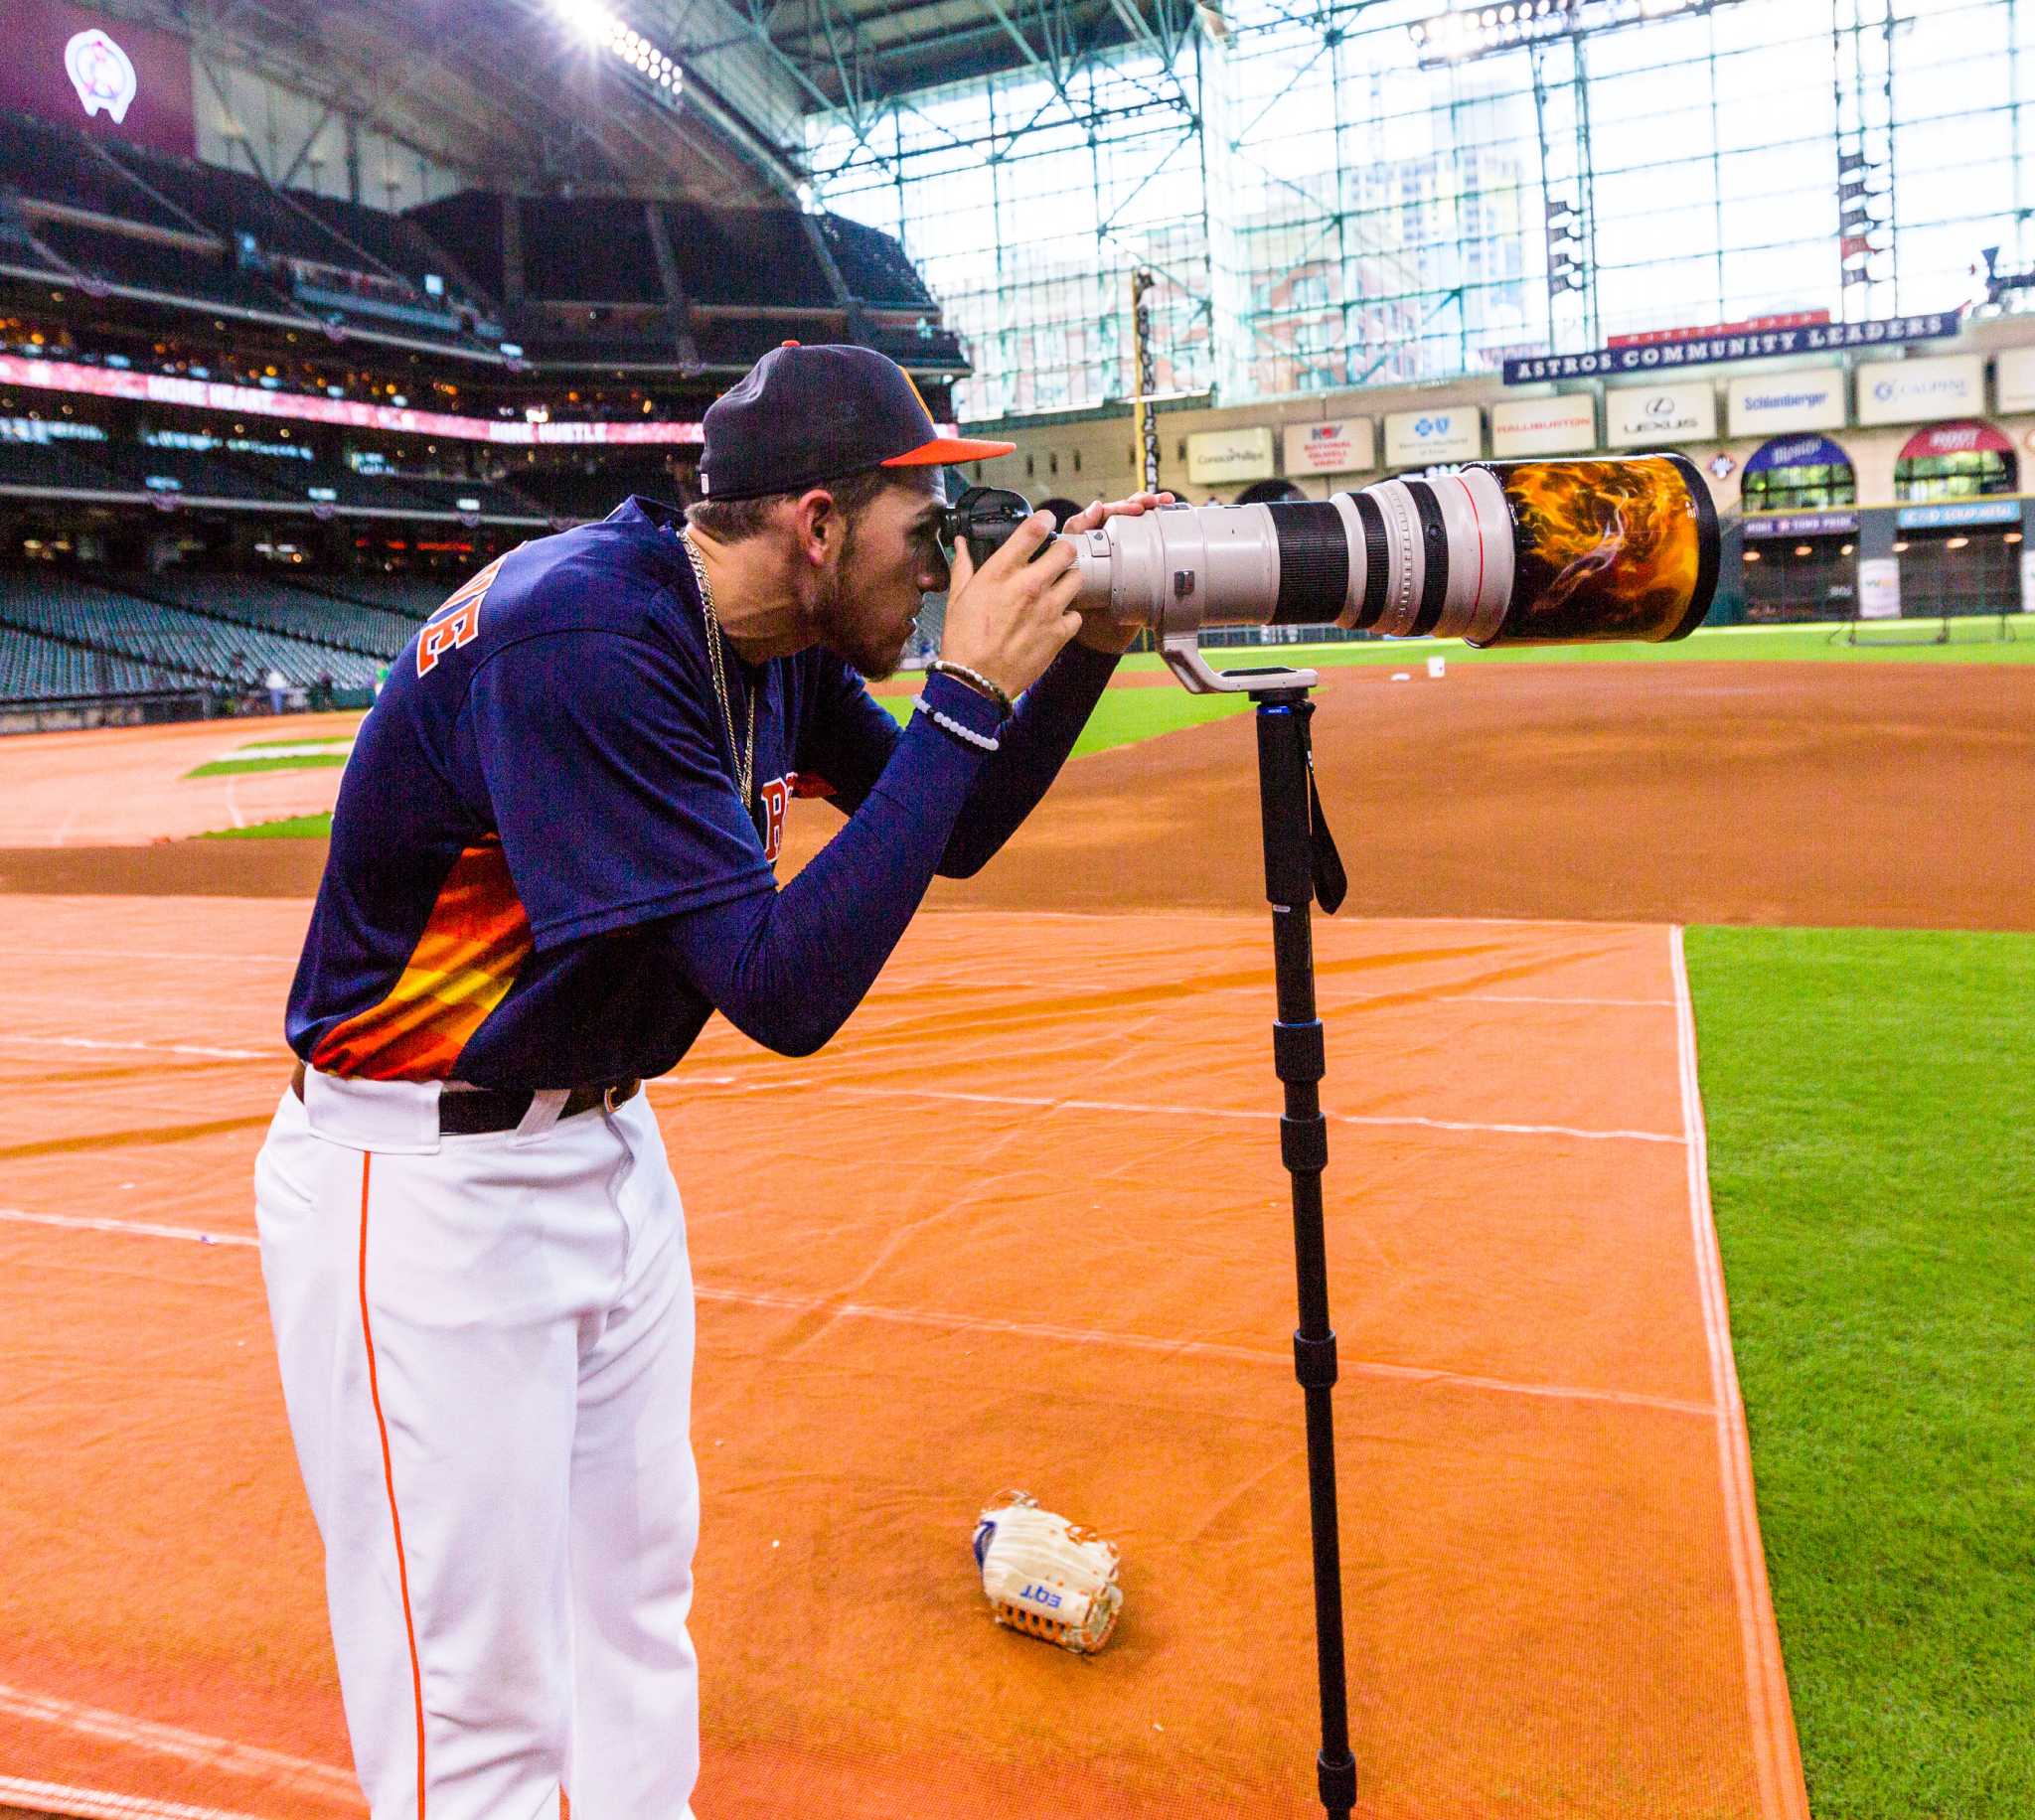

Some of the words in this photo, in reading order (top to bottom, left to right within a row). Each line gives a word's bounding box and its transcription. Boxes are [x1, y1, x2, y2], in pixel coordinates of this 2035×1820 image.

[1517, 353, 1612, 379] ASTROS
[1623, 332, 1798, 368] COMMUNITY
[1808, 316, 1942, 348] LEADERS
[1745, 392, 1828, 411] Schlumberger
[1496, 416, 1591, 434] HALLIBURTON
[1625, 418, 1698, 433] LEXUS
[1019, 1585, 1062, 1608] EQT
